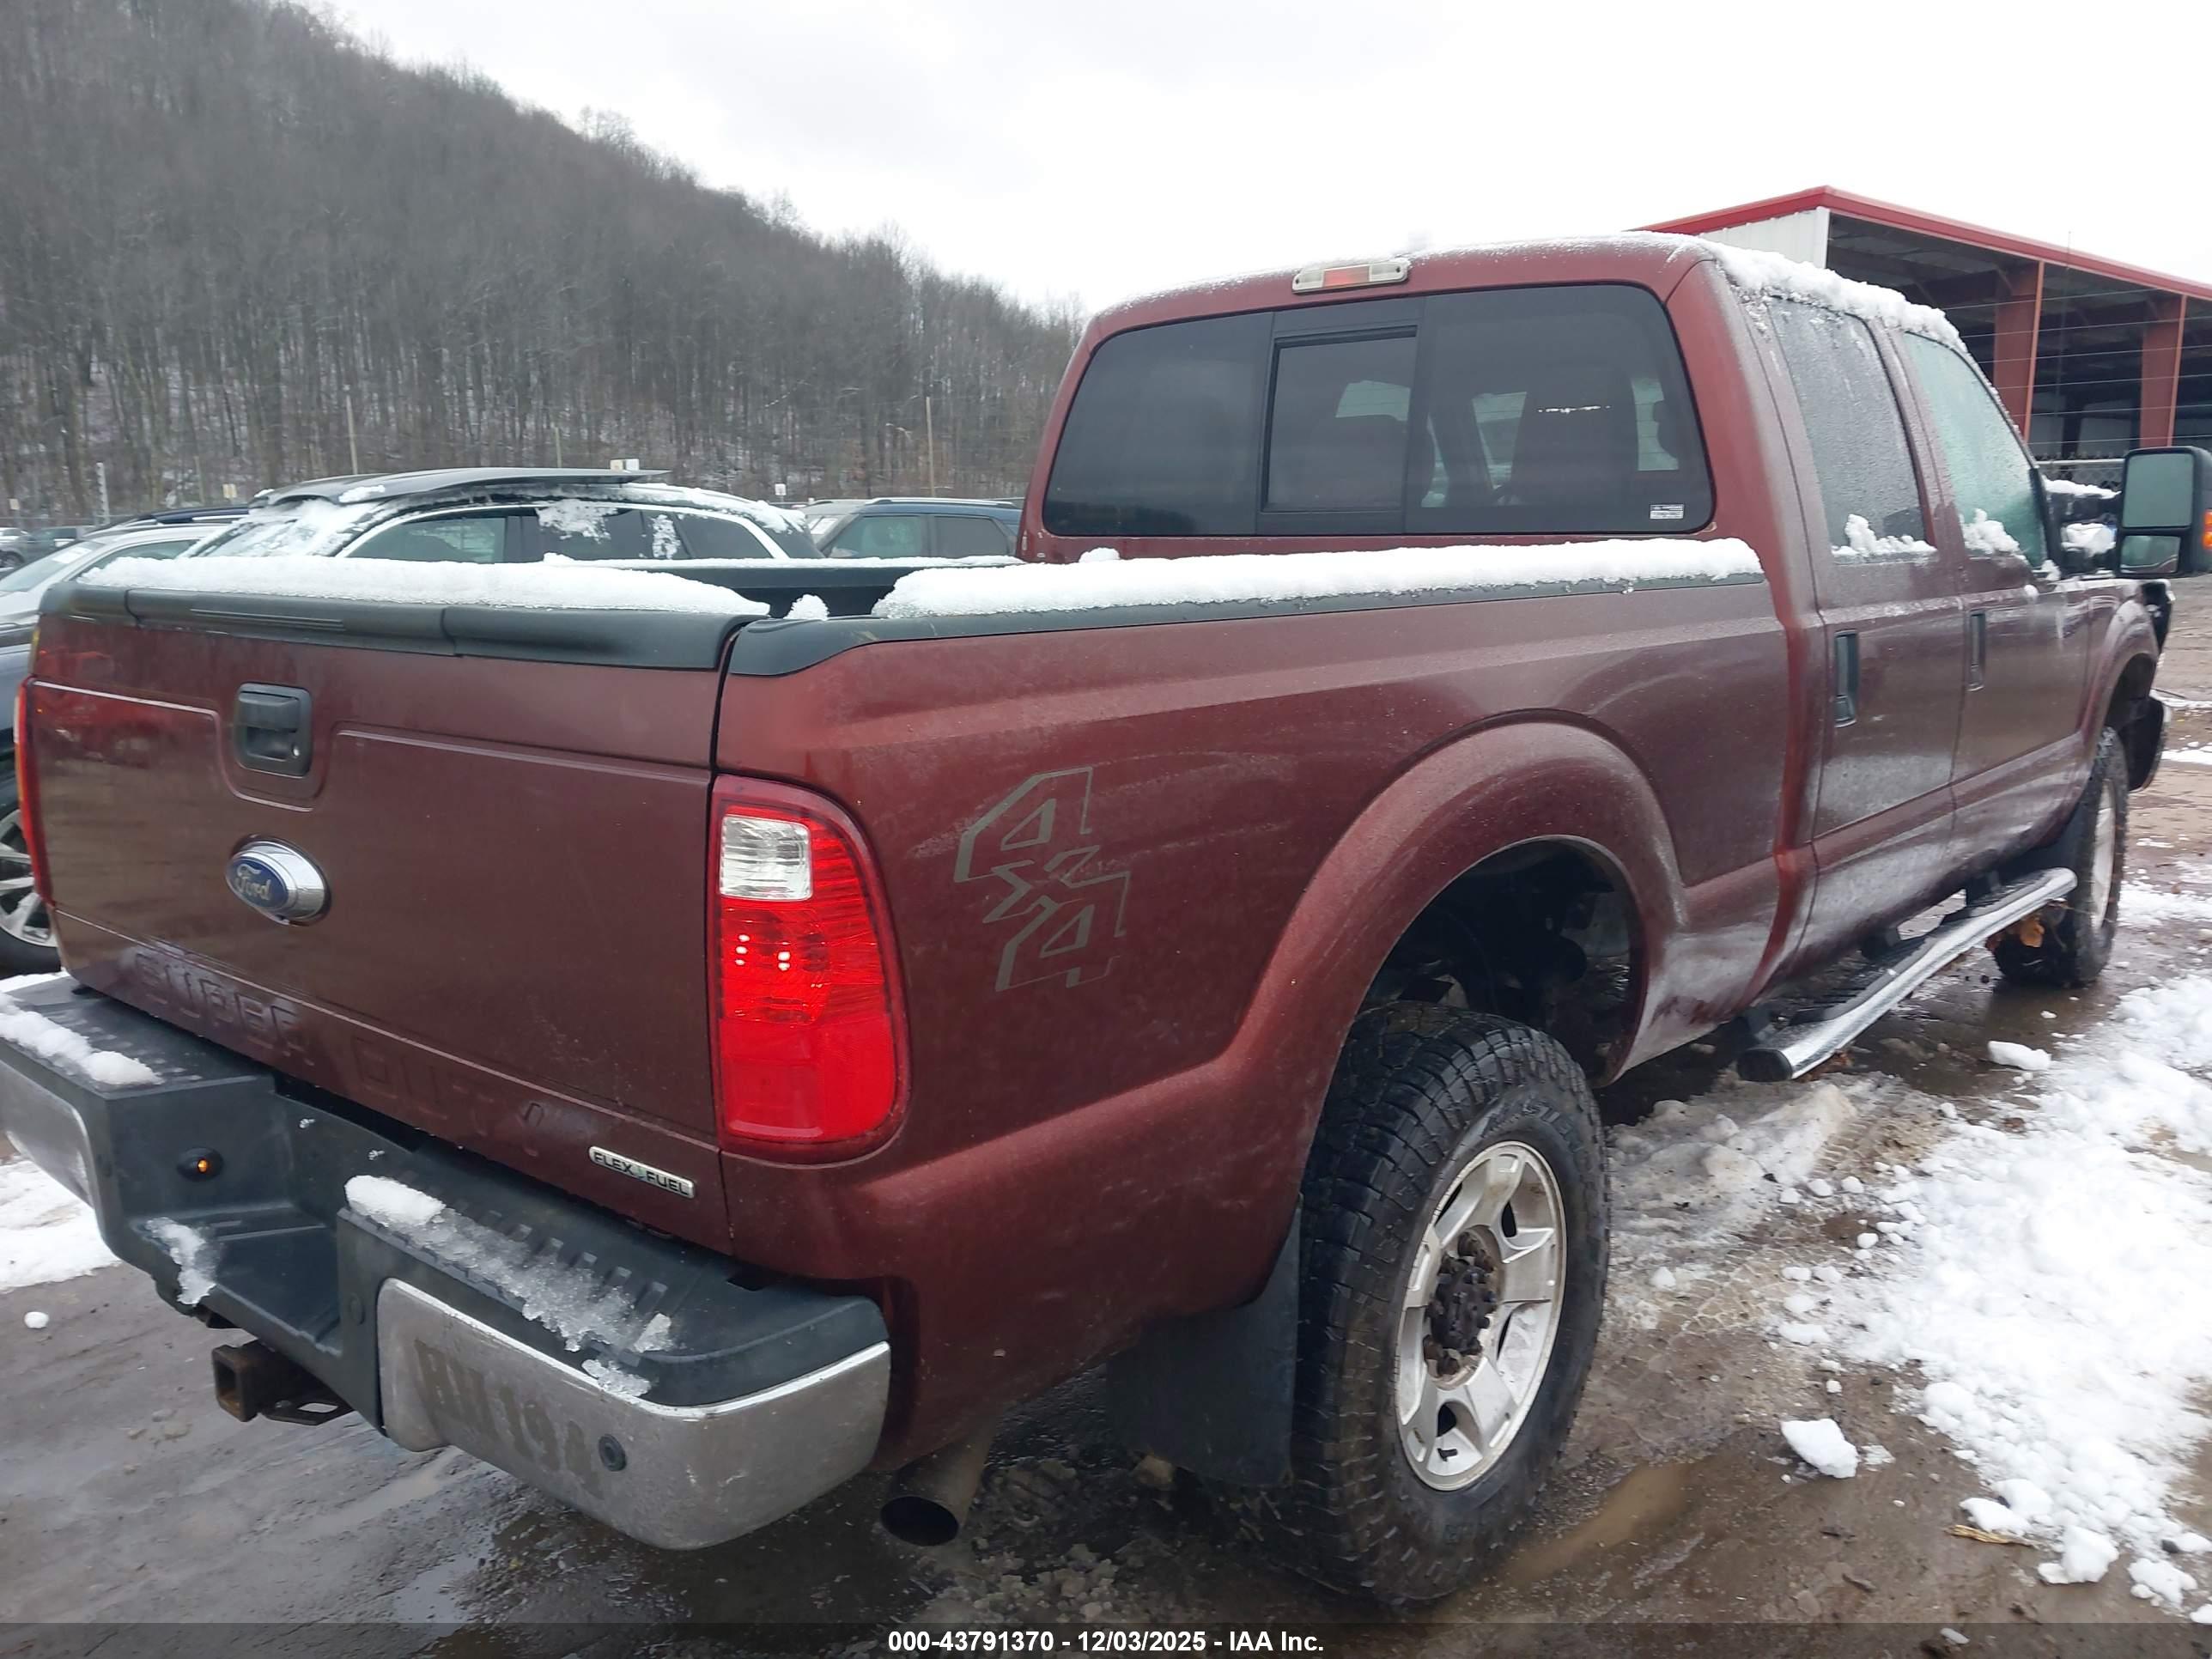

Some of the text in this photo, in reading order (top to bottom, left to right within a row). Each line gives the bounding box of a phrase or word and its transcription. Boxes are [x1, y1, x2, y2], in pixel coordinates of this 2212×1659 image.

[234, 863, 272, 901] Ford
[134, 952, 314, 1067] SUPER
[593, 1151, 690, 1196] FLEX FUEL
